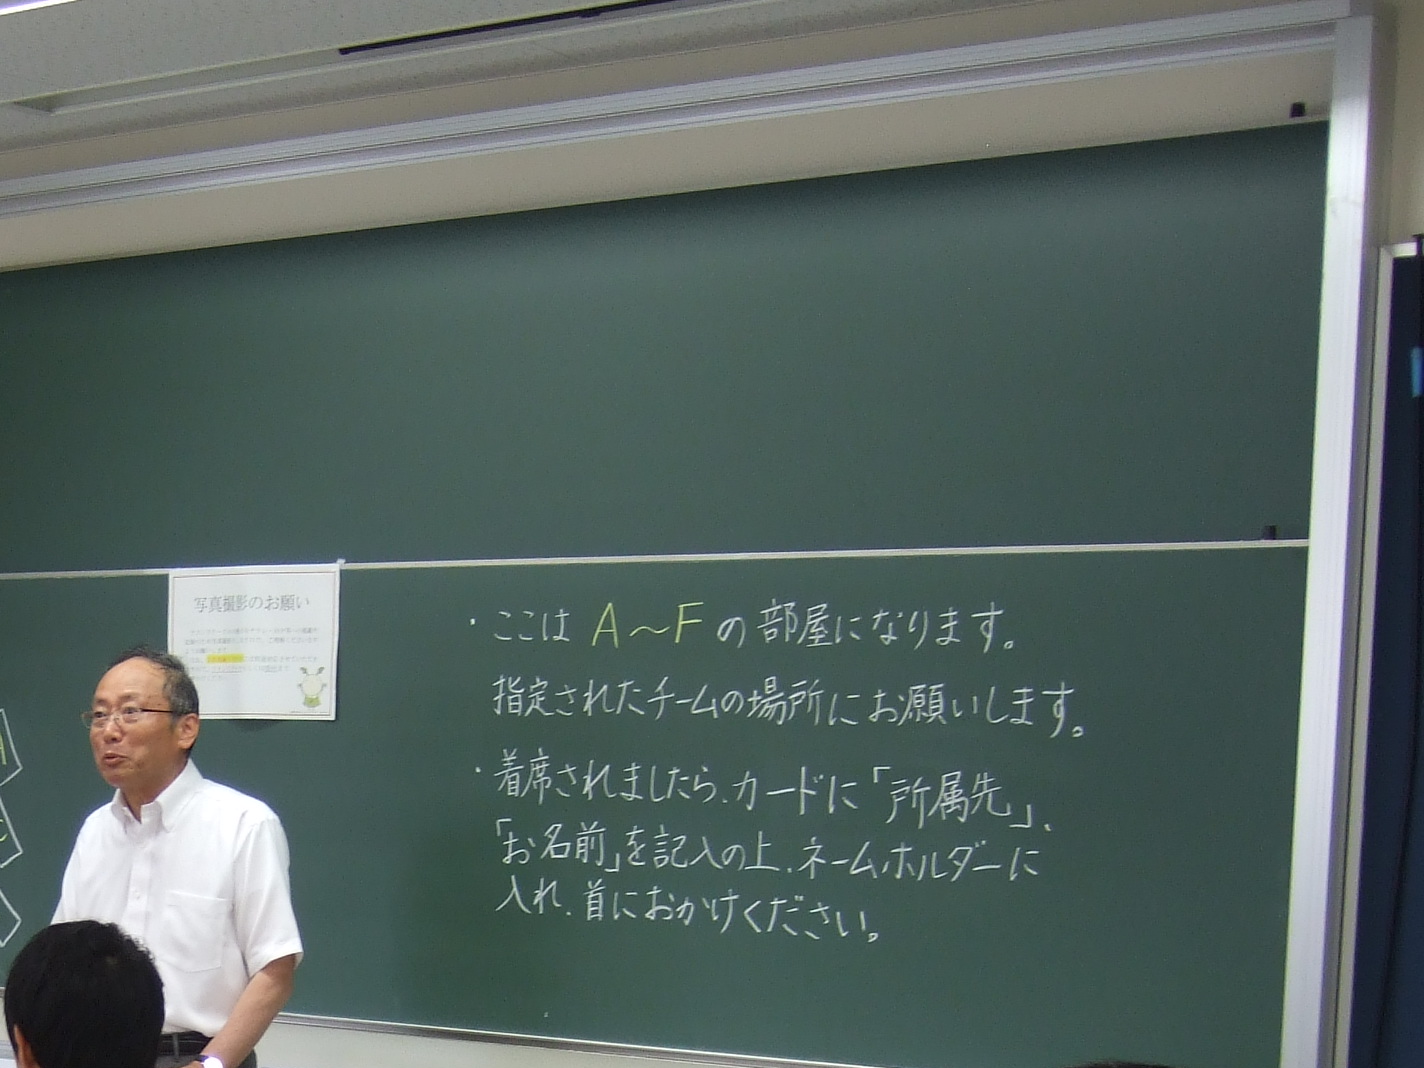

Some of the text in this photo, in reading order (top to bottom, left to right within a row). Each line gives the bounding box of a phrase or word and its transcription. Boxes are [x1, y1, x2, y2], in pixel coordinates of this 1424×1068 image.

[194, 593, 310, 613] 写真撮影のお願い
[492, 673, 1084, 738] 指定されたチームの場所にお願いします。
[494, 874, 878, 943] 入れ、首におかけください。
